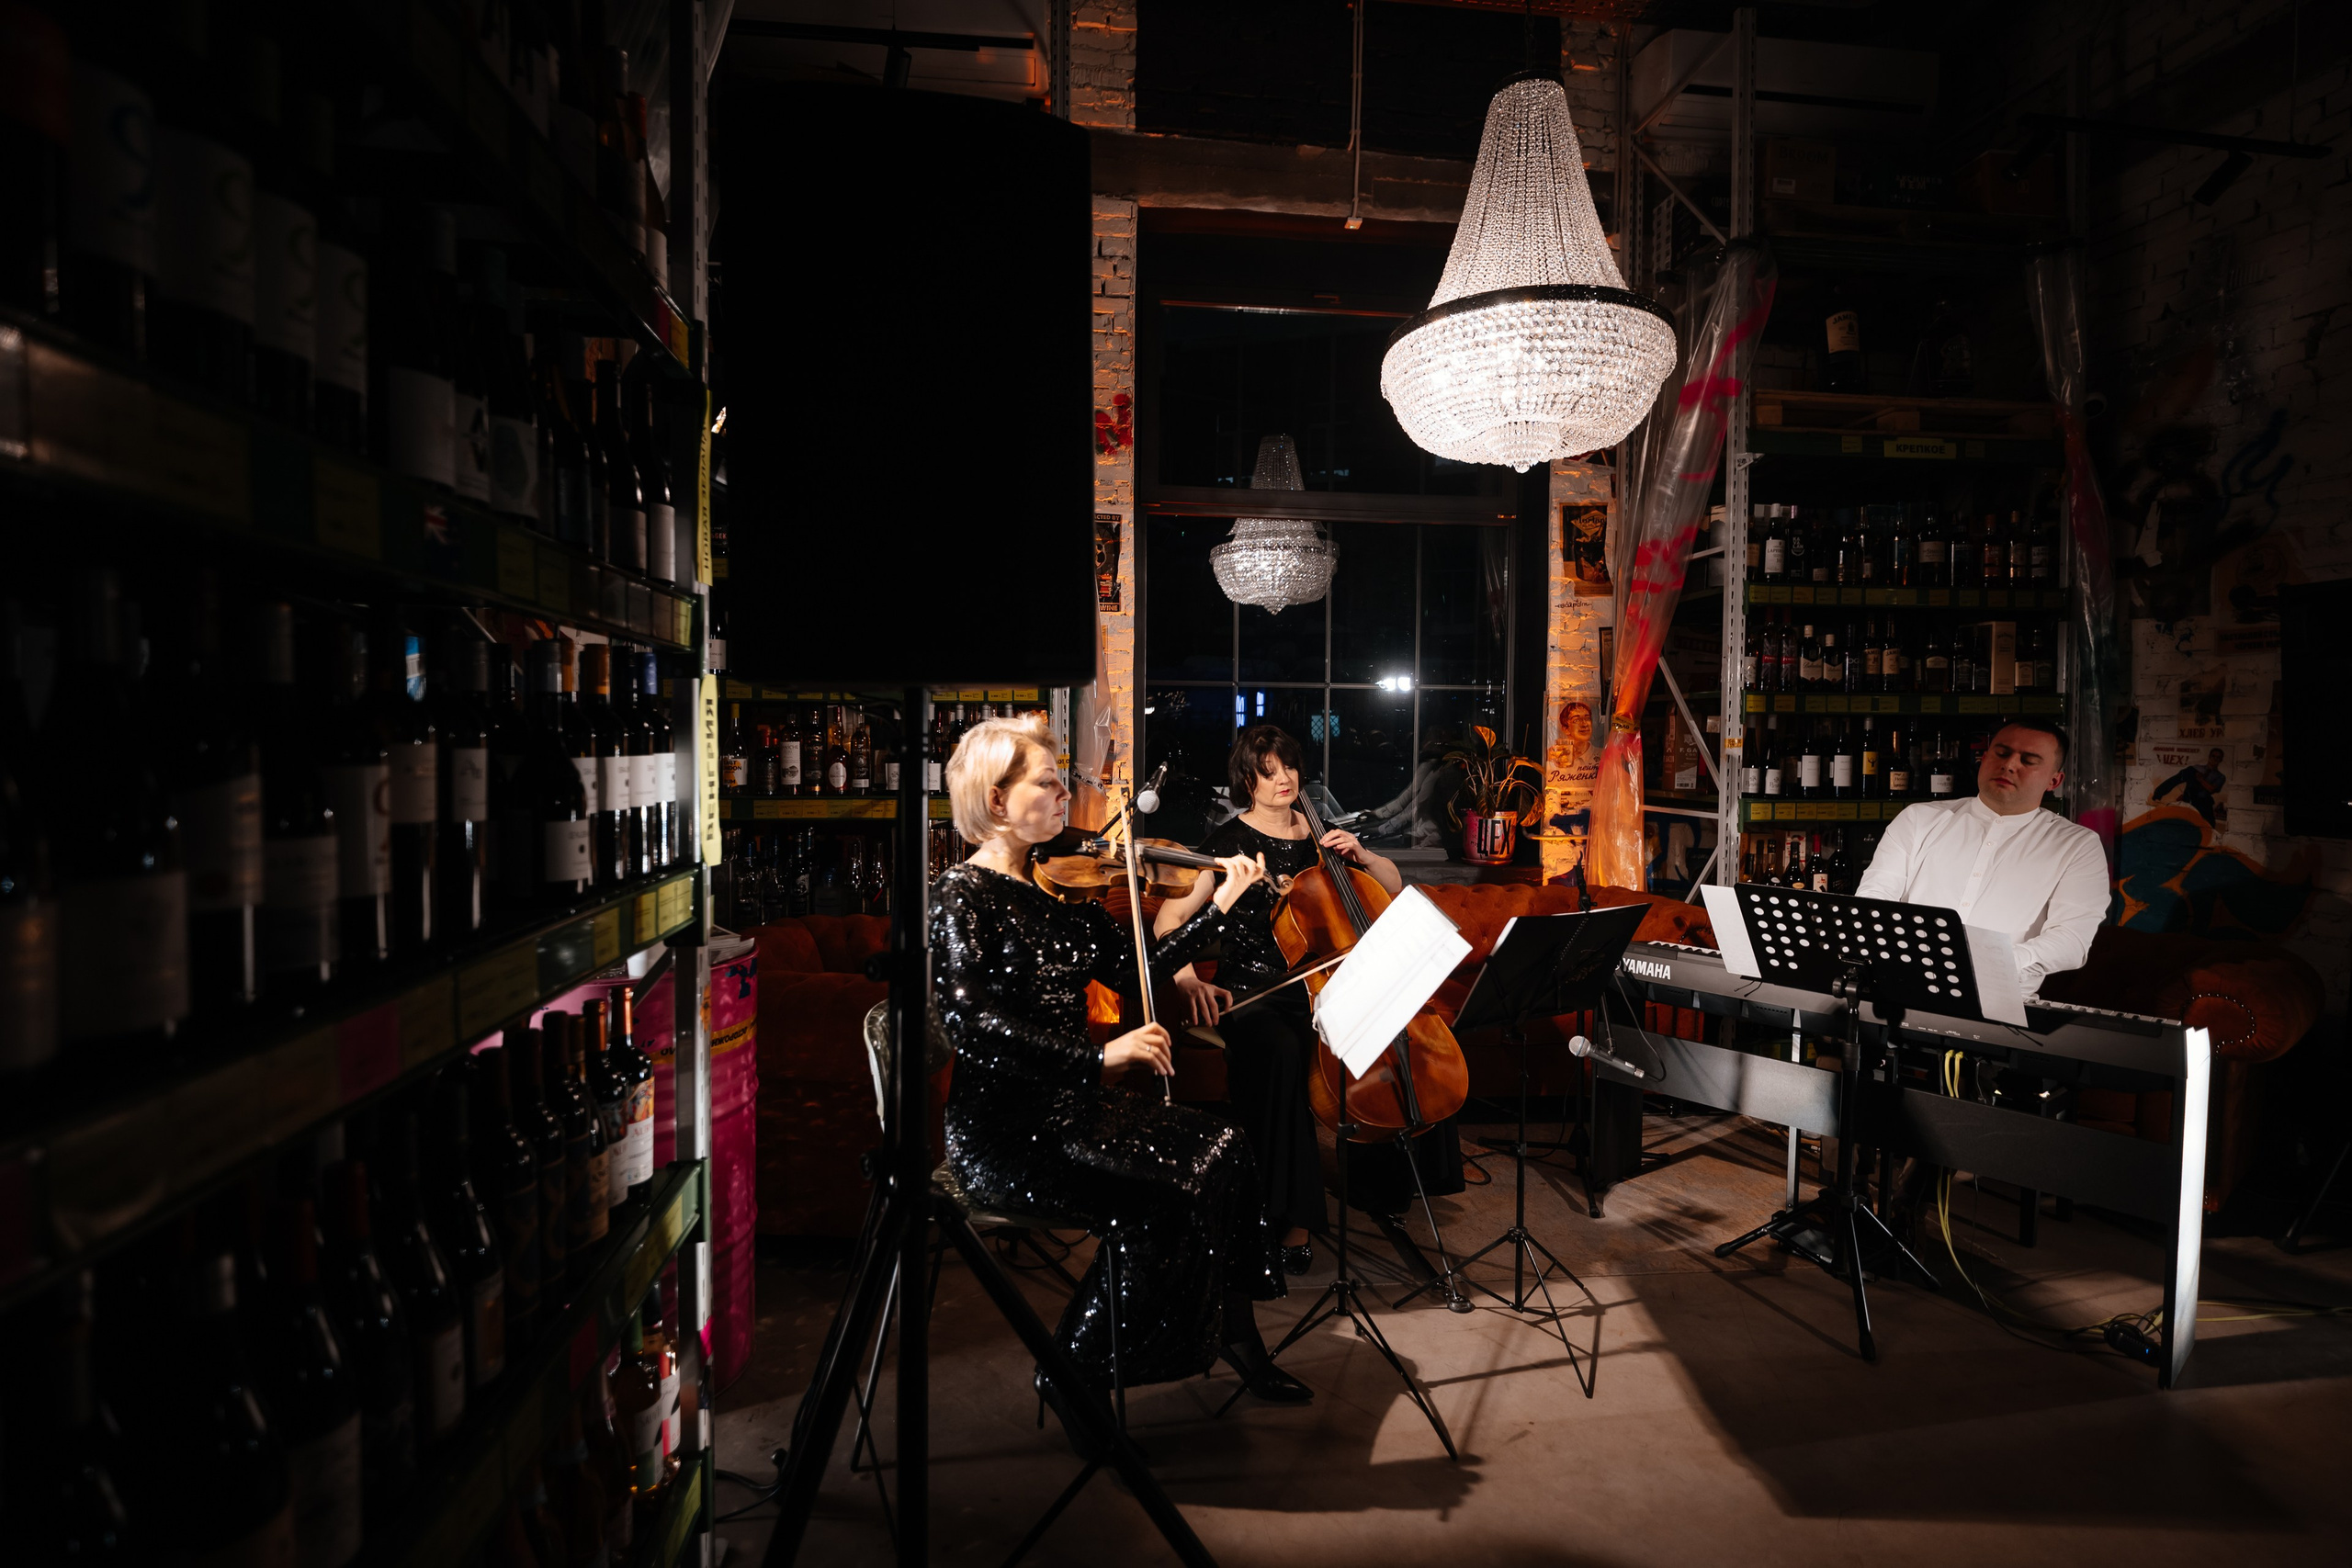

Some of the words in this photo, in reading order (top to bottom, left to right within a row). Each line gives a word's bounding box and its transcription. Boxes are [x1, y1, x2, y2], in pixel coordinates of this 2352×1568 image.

[1779, 146, 1829, 164] BROOM
[1895, 444, 1946, 454] КРЕПКОЕ
[701, 506, 709, 570] НОВАЯ
[2178, 728, 2206, 739] ХЛЕБ
[706, 699, 715, 840] ВЕНГРИЯ
[2163, 754, 2189, 765] ЦЕХ!
[1477, 818, 1511, 856] ЦЕХ
[1623, 957, 1671, 980] YAMAHA
